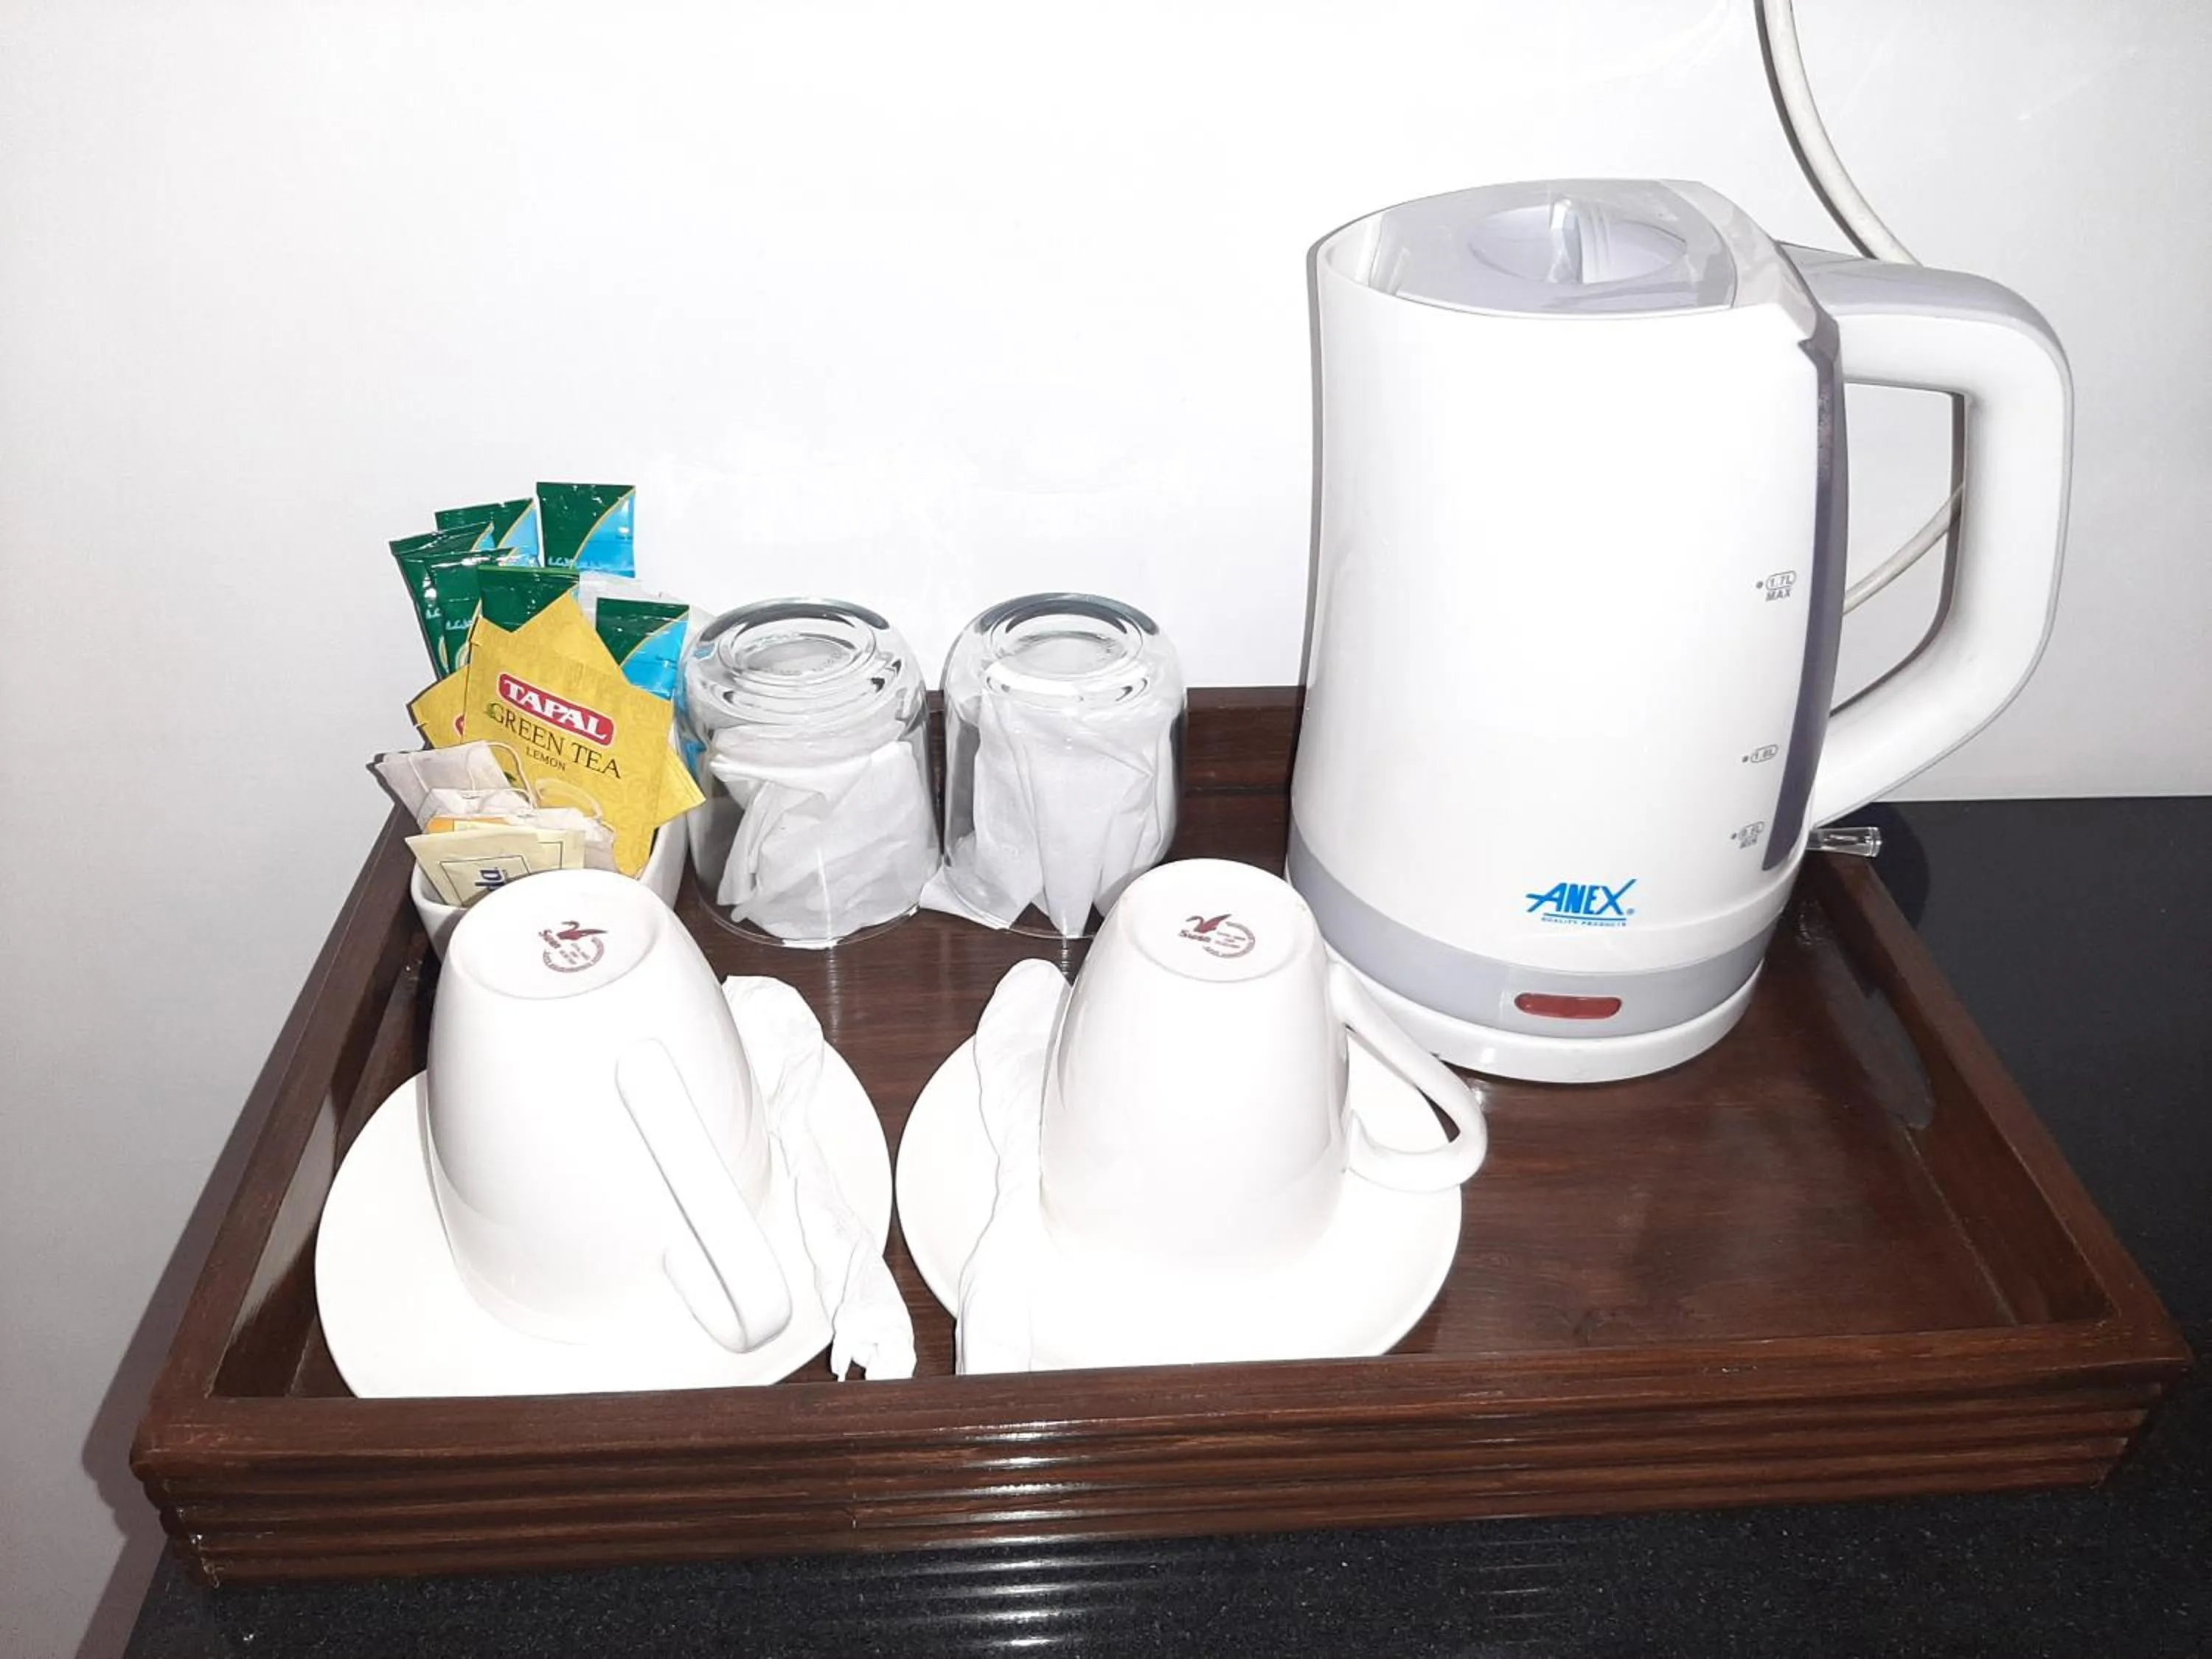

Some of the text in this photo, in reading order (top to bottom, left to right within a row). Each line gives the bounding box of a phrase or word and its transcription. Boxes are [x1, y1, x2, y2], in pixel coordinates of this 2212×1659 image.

[1766, 589, 1791, 602] MAX
[504, 680, 607, 740] TAPAL
[486, 701, 621, 779] GREEN TEA
[526, 746, 567, 772] LEMON
[1526, 878, 1638, 916] ANEX
